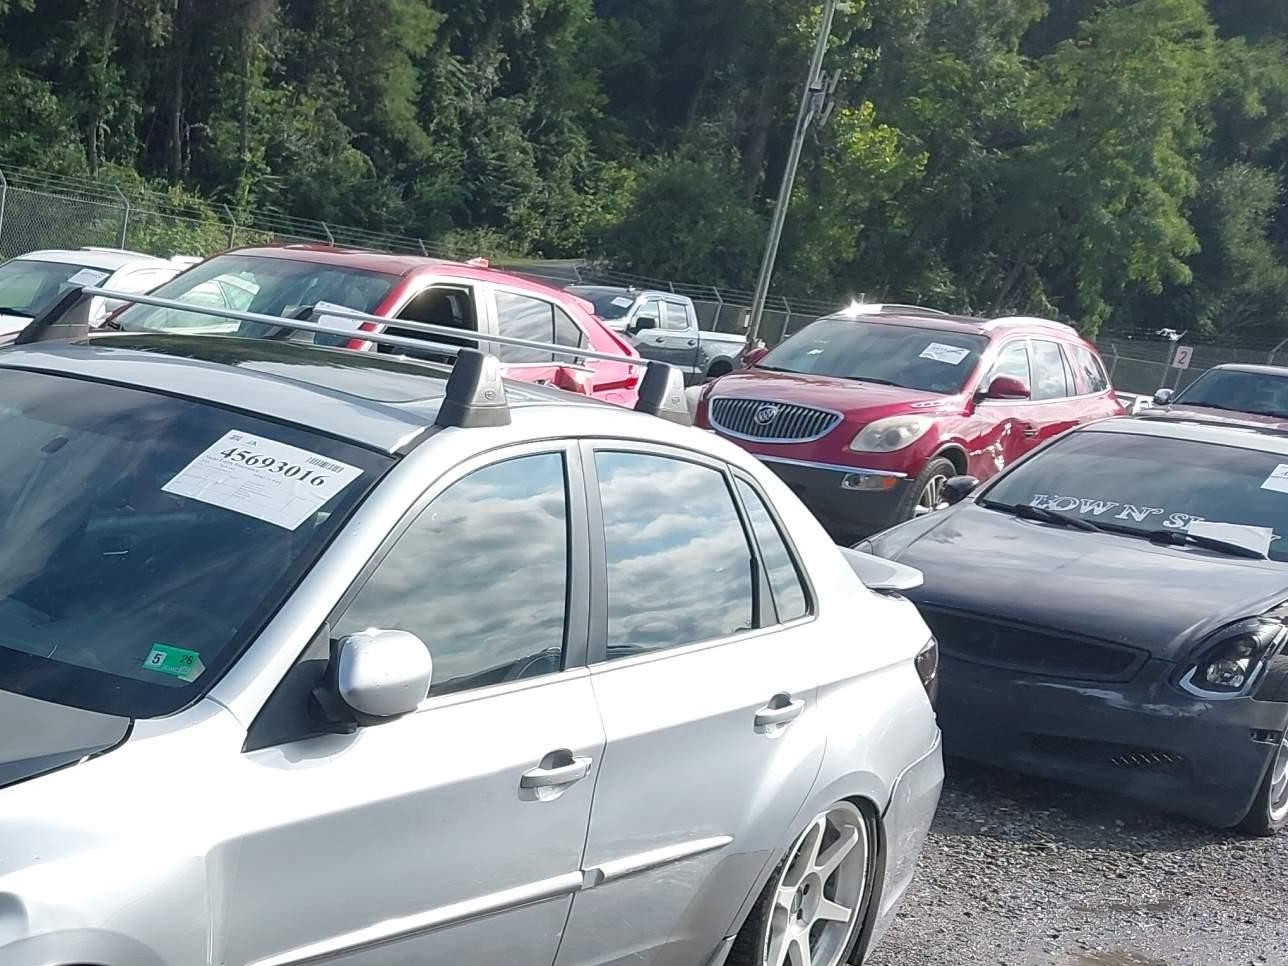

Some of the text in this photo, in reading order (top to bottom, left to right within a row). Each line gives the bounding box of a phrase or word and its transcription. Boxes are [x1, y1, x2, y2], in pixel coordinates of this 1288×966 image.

[1177, 350, 1188, 365] 2
[220, 447, 330, 488] 45693016
[1029, 494, 1119, 516] LOW
[152, 653, 163, 664] 5
[180, 654, 194, 665] 26
